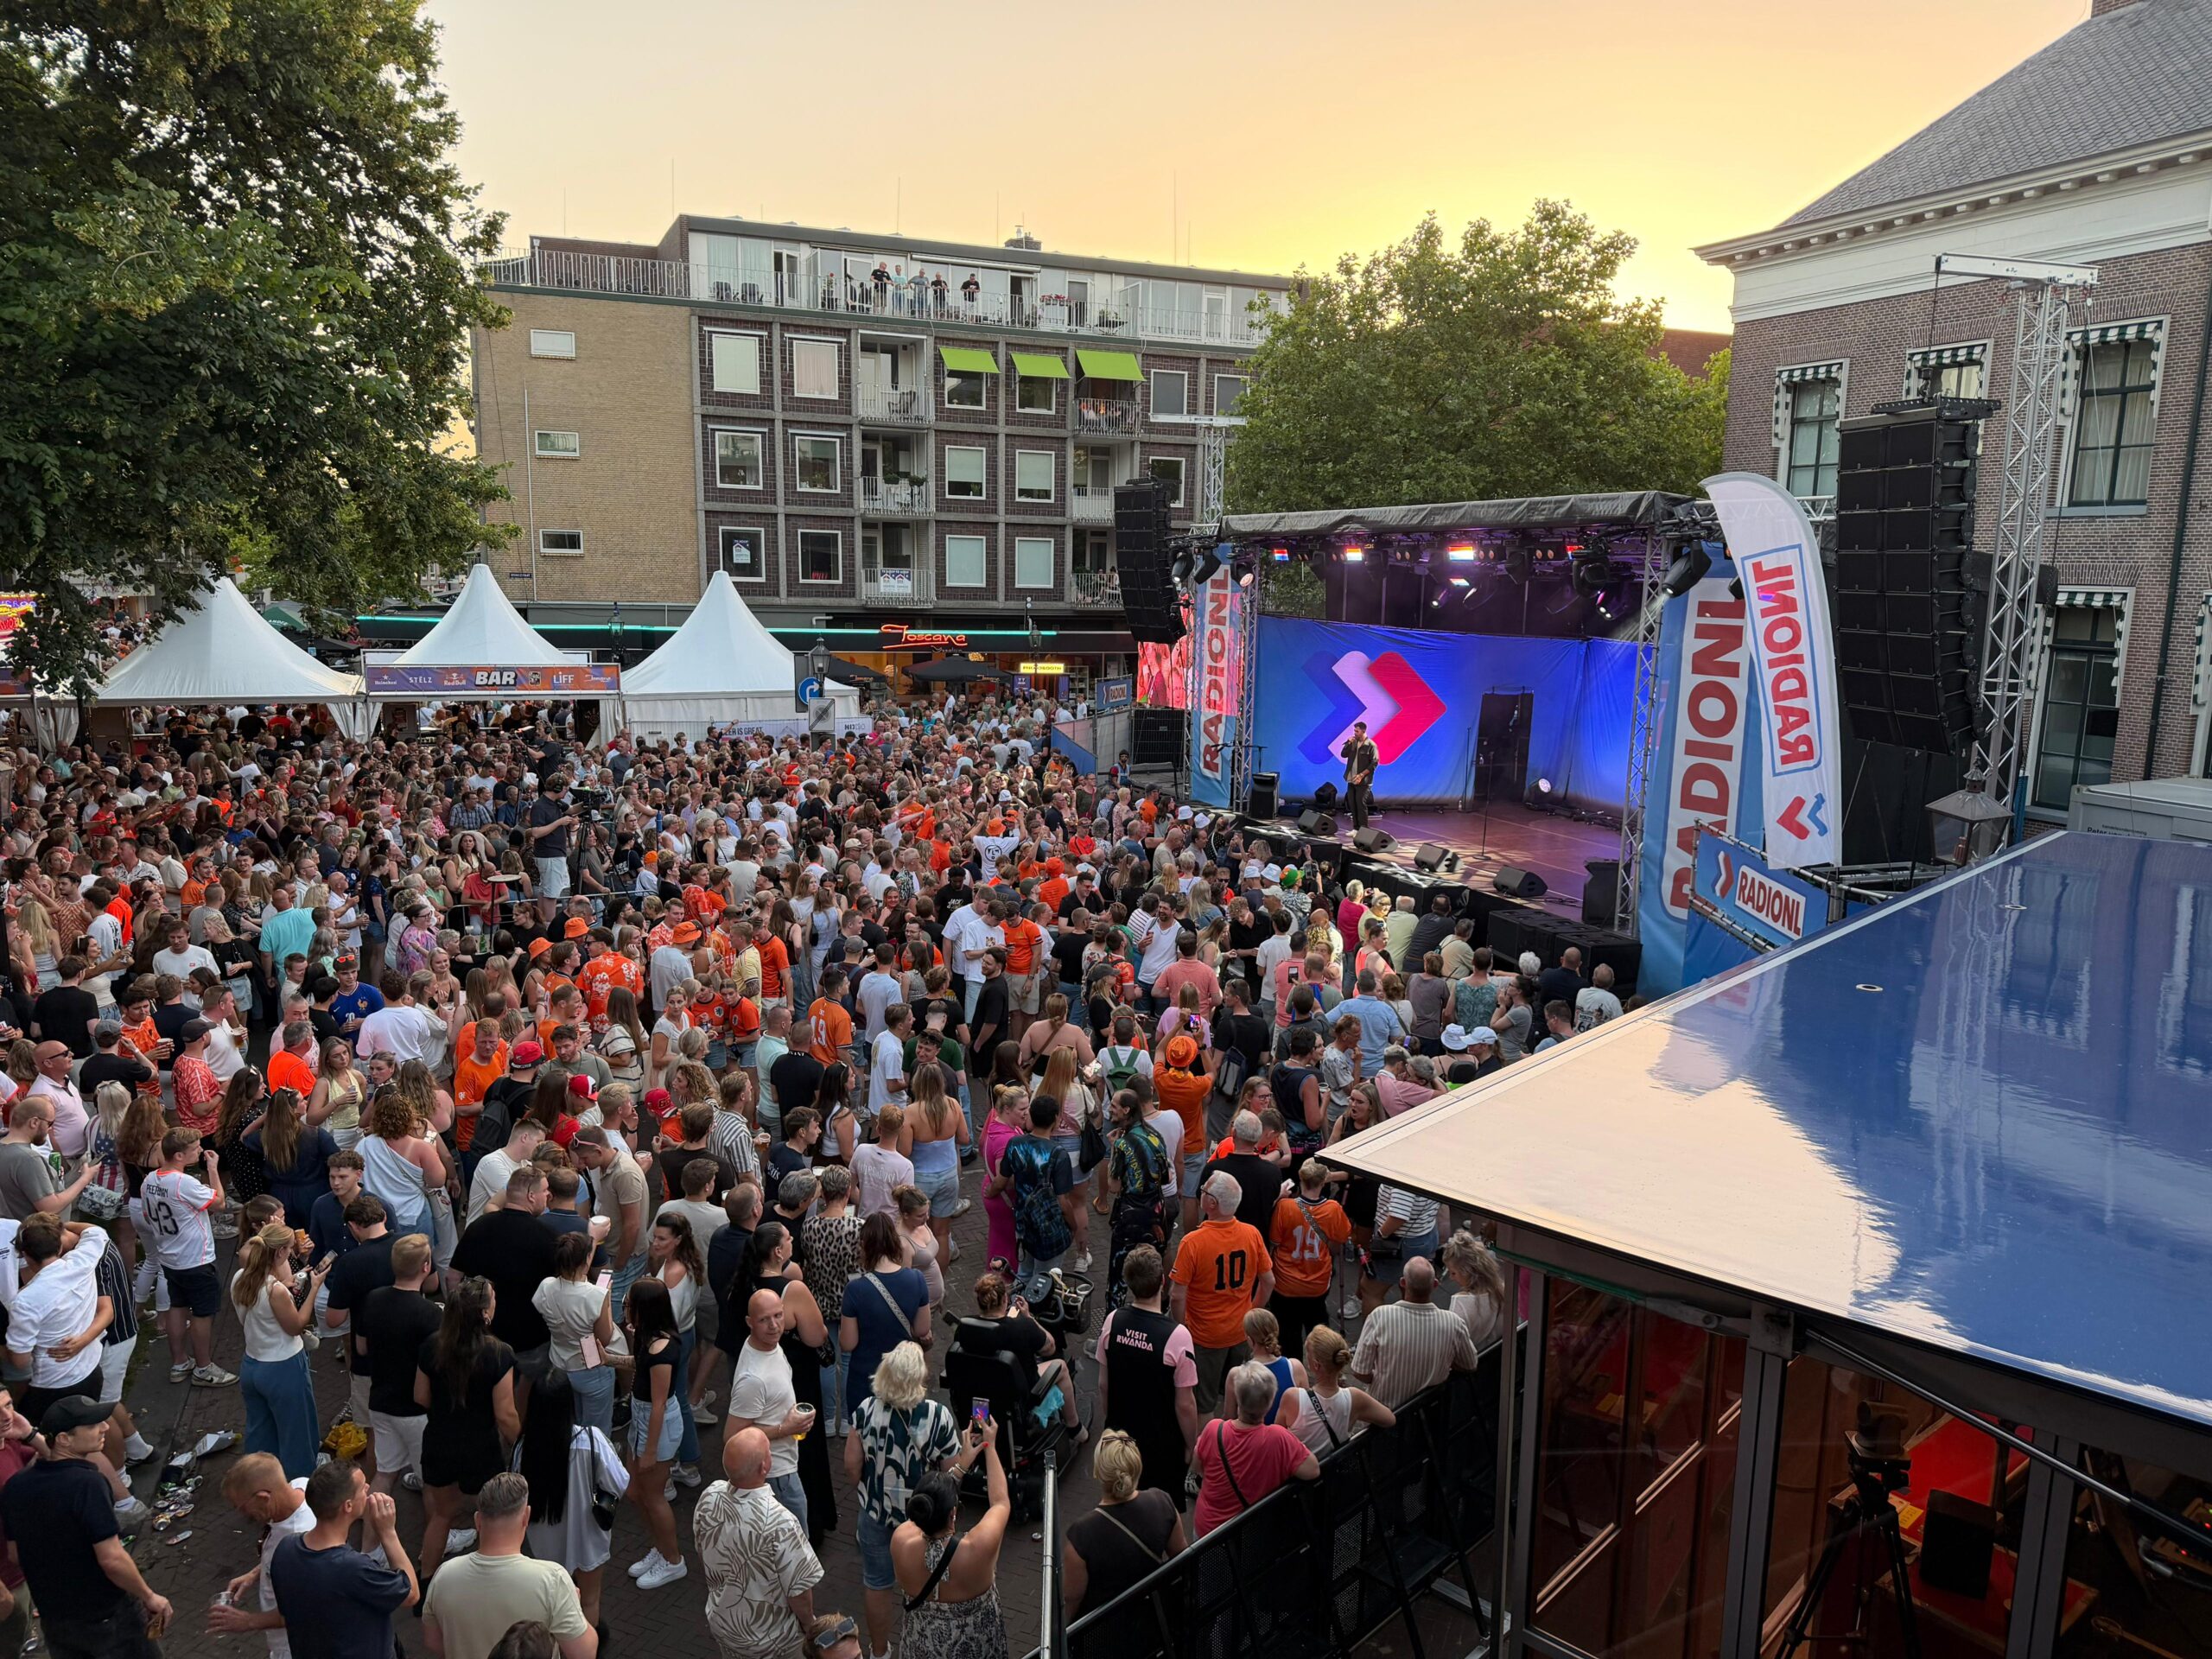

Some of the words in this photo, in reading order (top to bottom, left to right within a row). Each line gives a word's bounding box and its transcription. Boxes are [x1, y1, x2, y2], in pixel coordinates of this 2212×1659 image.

[880, 624, 968, 646] Toscana
[475, 671, 517, 685] BAR
[1203, 569, 1229, 773] RADIONL
[1738, 869, 1803, 938] RADIONL
[146, 1198, 180, 1236] 43
[1215, 1249, 1246, 1291] 10
[1116, 1334, 1154, 1351] RWANDA
[1126, 1328, 1147, 1340] VISIT
